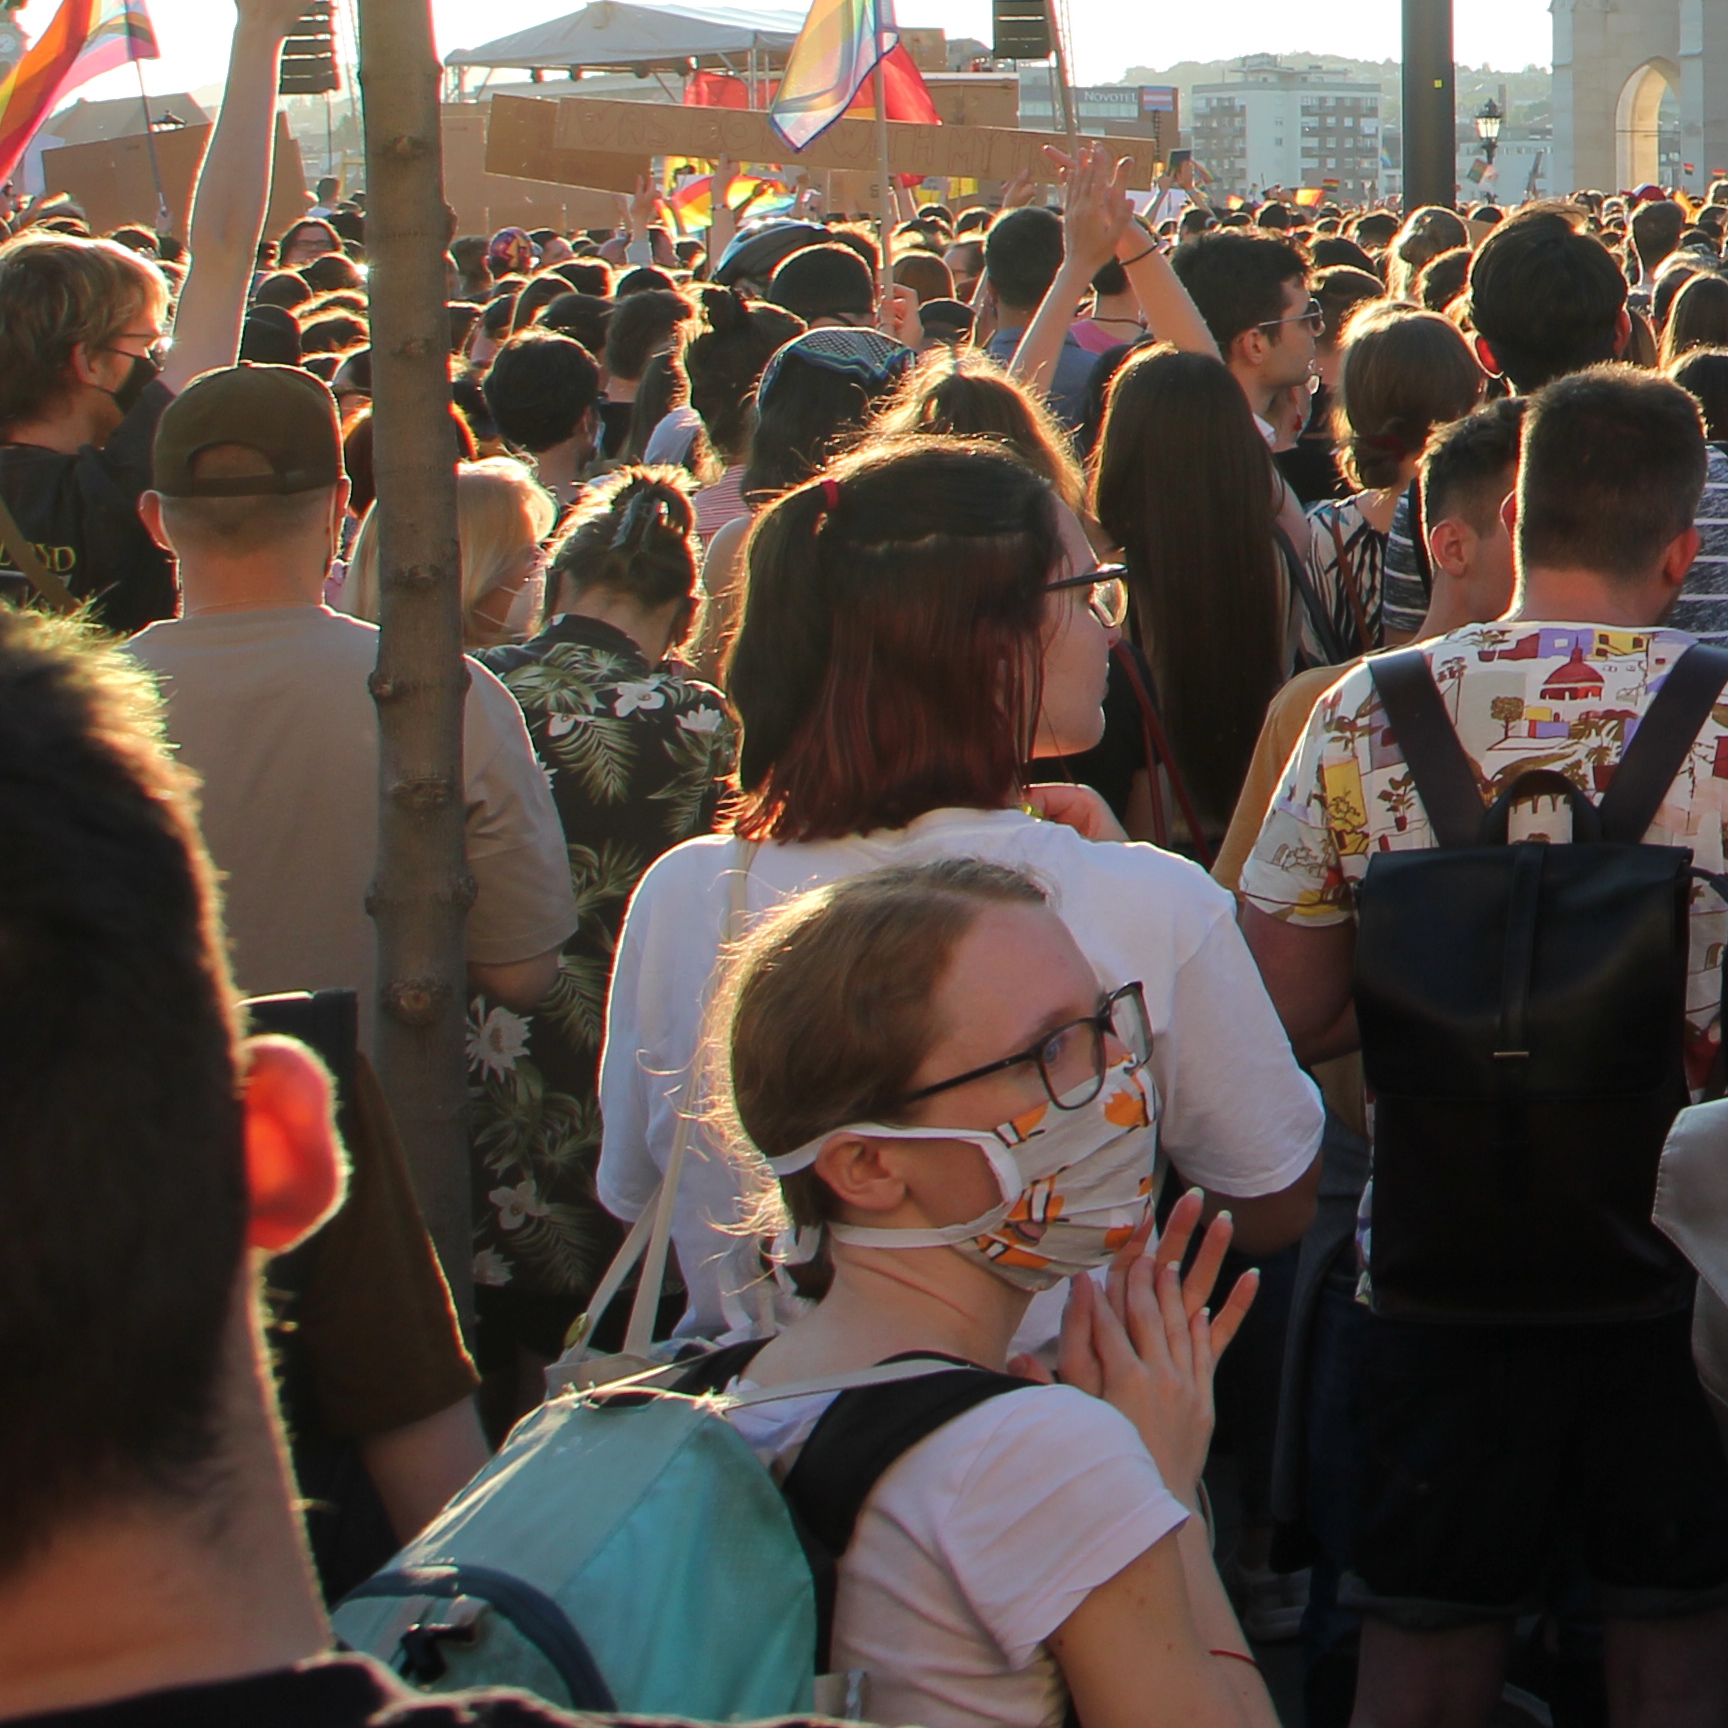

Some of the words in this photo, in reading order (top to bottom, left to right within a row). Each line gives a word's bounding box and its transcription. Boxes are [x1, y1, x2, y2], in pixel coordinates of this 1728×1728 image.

[1084, 91, 1137, 103] NOVOTEL
[576, 102, 674, 149] WAS
[947, 126, 1004, 174] MY
